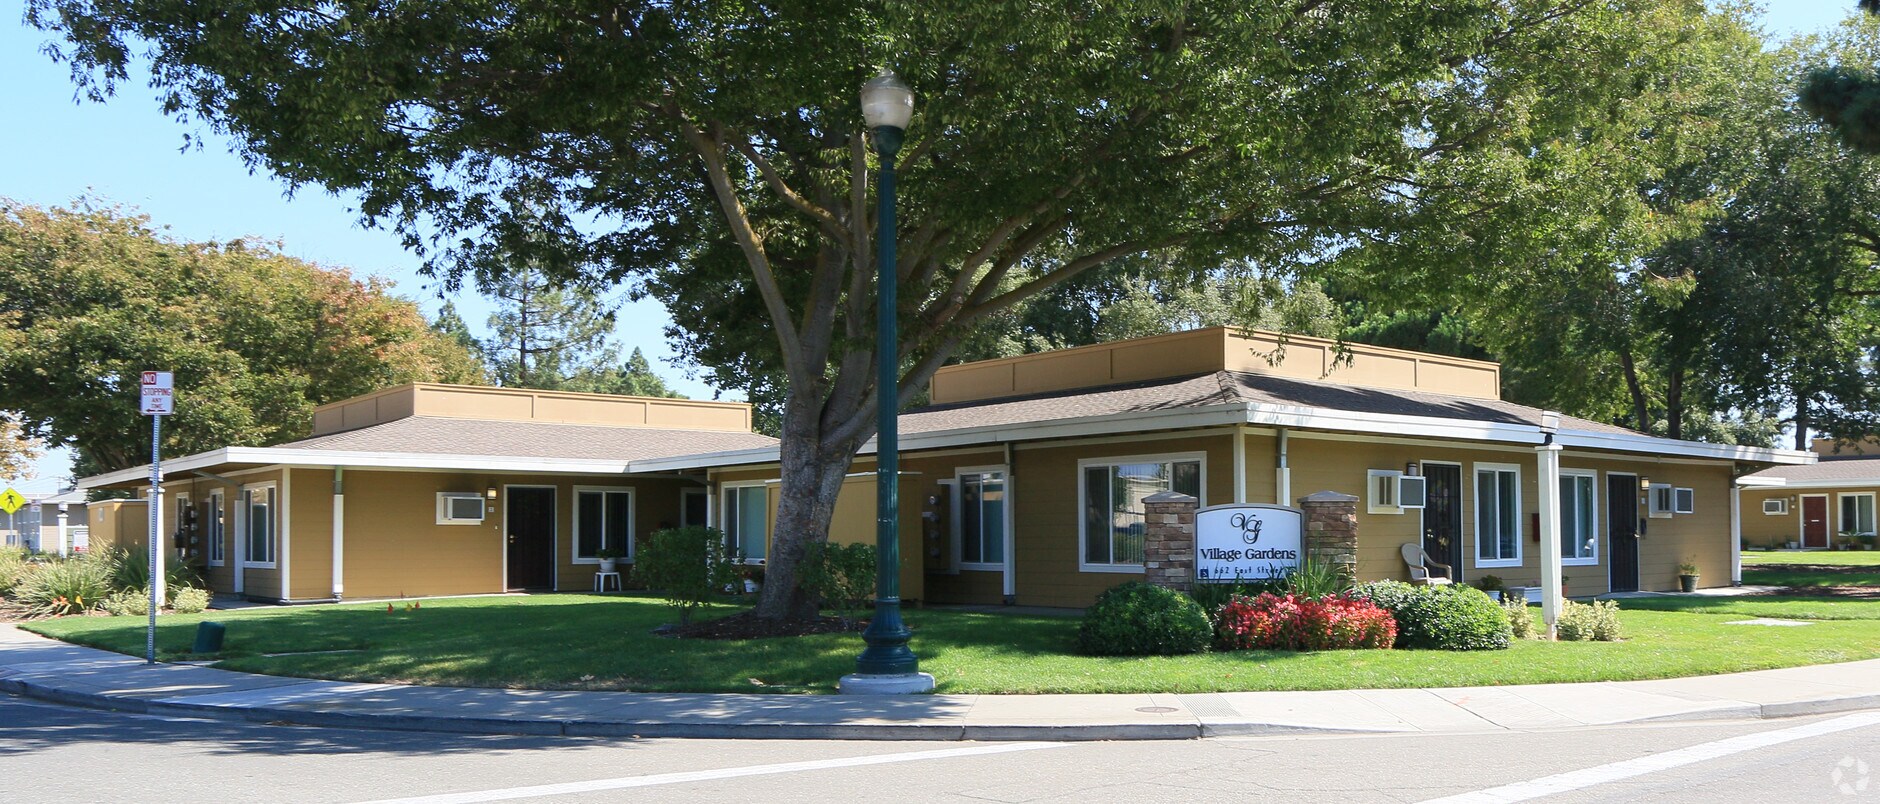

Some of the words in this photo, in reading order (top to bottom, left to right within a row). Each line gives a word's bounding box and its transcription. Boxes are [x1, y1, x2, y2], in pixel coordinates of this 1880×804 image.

[143, 374, 156, 383] NO
[143, 388, 171, 396] STOPPING
[1200, 548, 1242, 562] Village
[1245, 548, 1296, 560] Gardens
[1234, 566, 1252, 574] East
